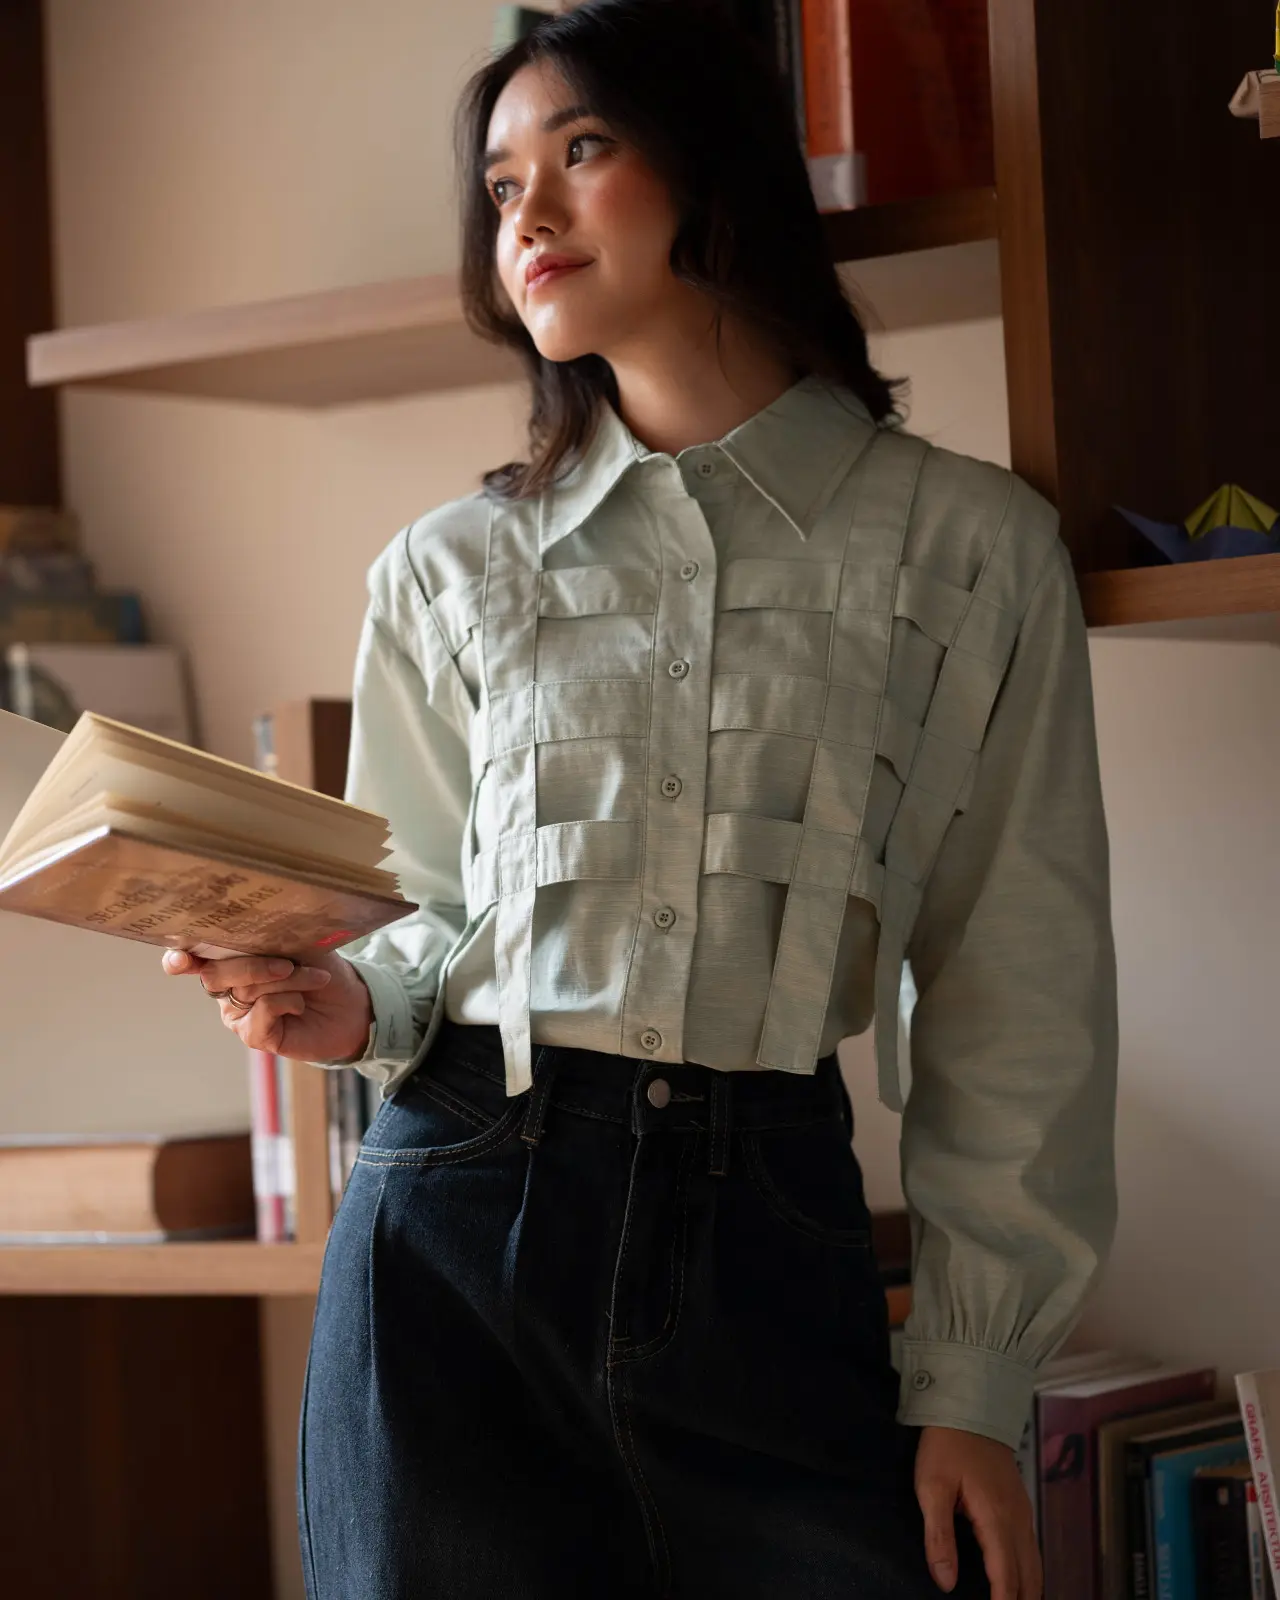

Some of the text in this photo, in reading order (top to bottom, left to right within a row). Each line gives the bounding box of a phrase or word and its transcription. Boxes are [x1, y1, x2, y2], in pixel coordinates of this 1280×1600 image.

[122, 892, 216, 936] JAPANESE
[189, 882, 284, 929] WARFARE
[1245, 1403, 1265, 1461] GRAFIK
